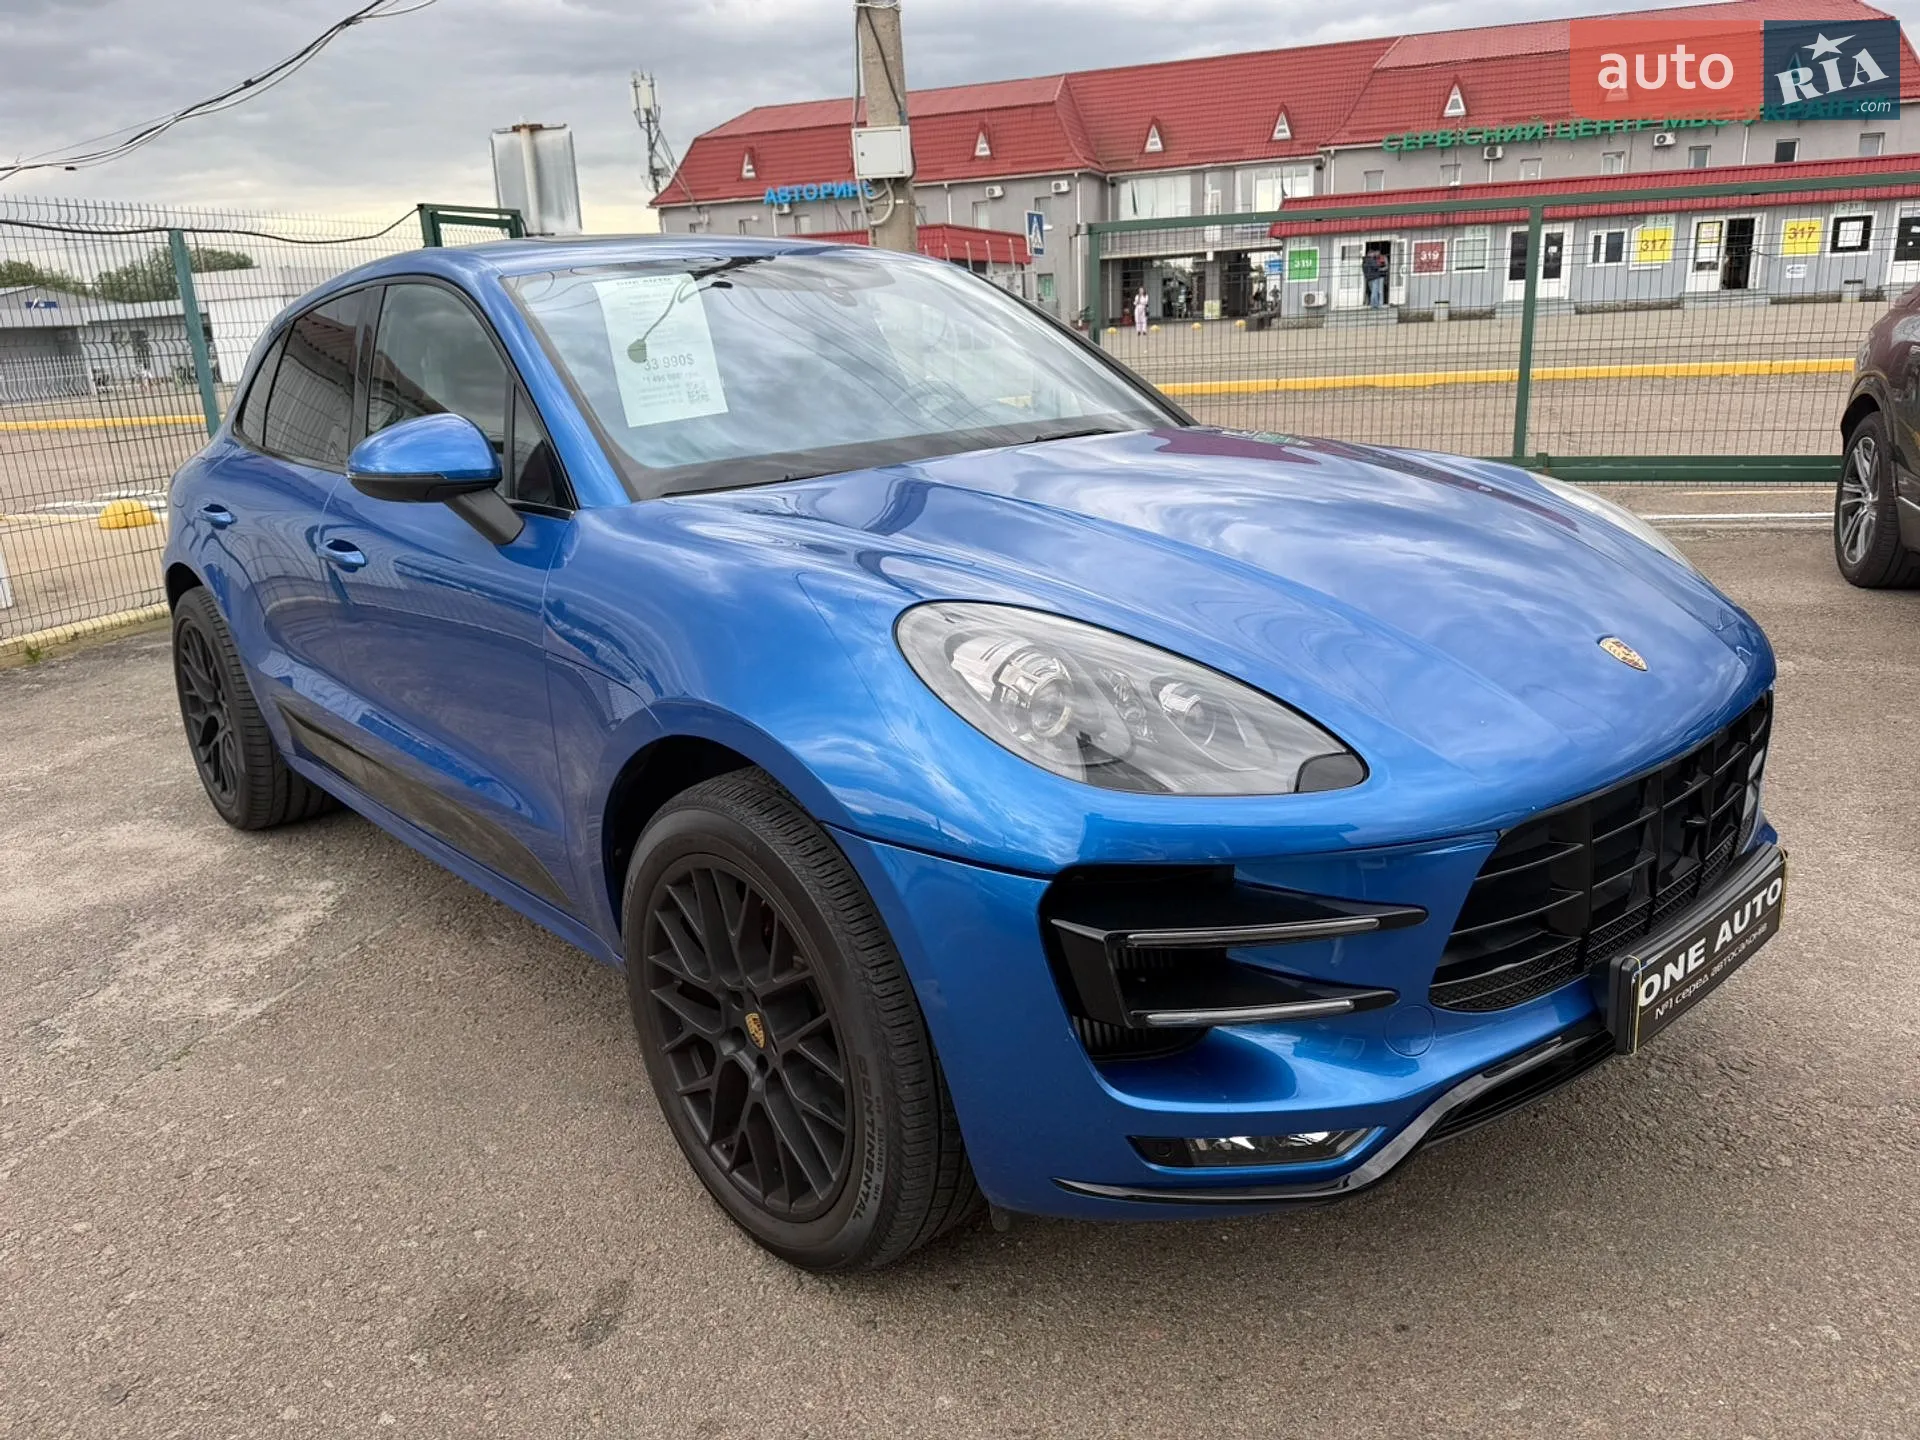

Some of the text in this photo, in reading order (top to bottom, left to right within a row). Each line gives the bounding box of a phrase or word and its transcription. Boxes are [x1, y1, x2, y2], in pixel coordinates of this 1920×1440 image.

[1382, 116, 1543, 152] СЕРВІСНИЙ
[1556, 113, 1654, 140] ЦЕНТР
[1641, 238, 1667, 251] 317
[1788, 226, 1816, 240] 317
[1639, 877, 1783, 1007] ONE AUTO
